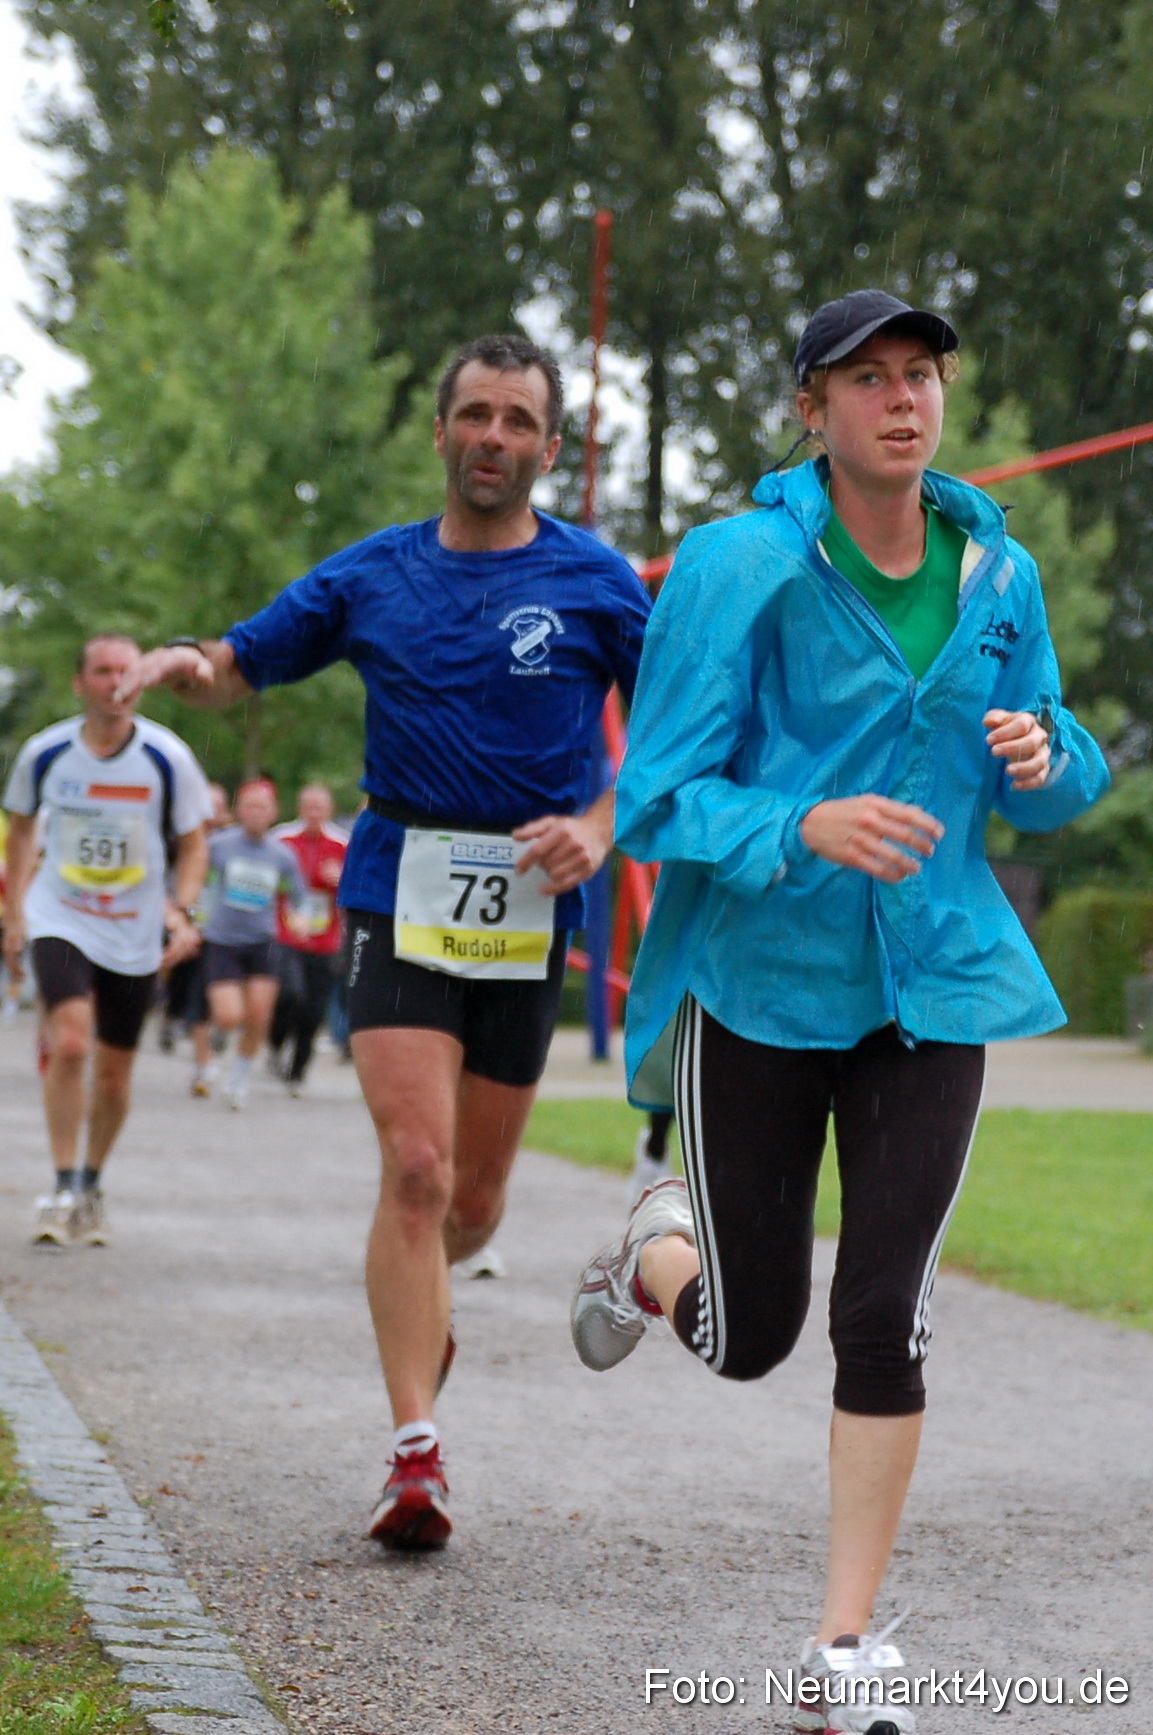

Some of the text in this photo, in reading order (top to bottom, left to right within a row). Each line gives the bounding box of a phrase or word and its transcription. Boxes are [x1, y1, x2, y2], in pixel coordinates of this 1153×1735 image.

[79, 838, 127, 866] 591
[449, 873, 509, 926] 73
[443, 936, 506, 958] Rudolf
